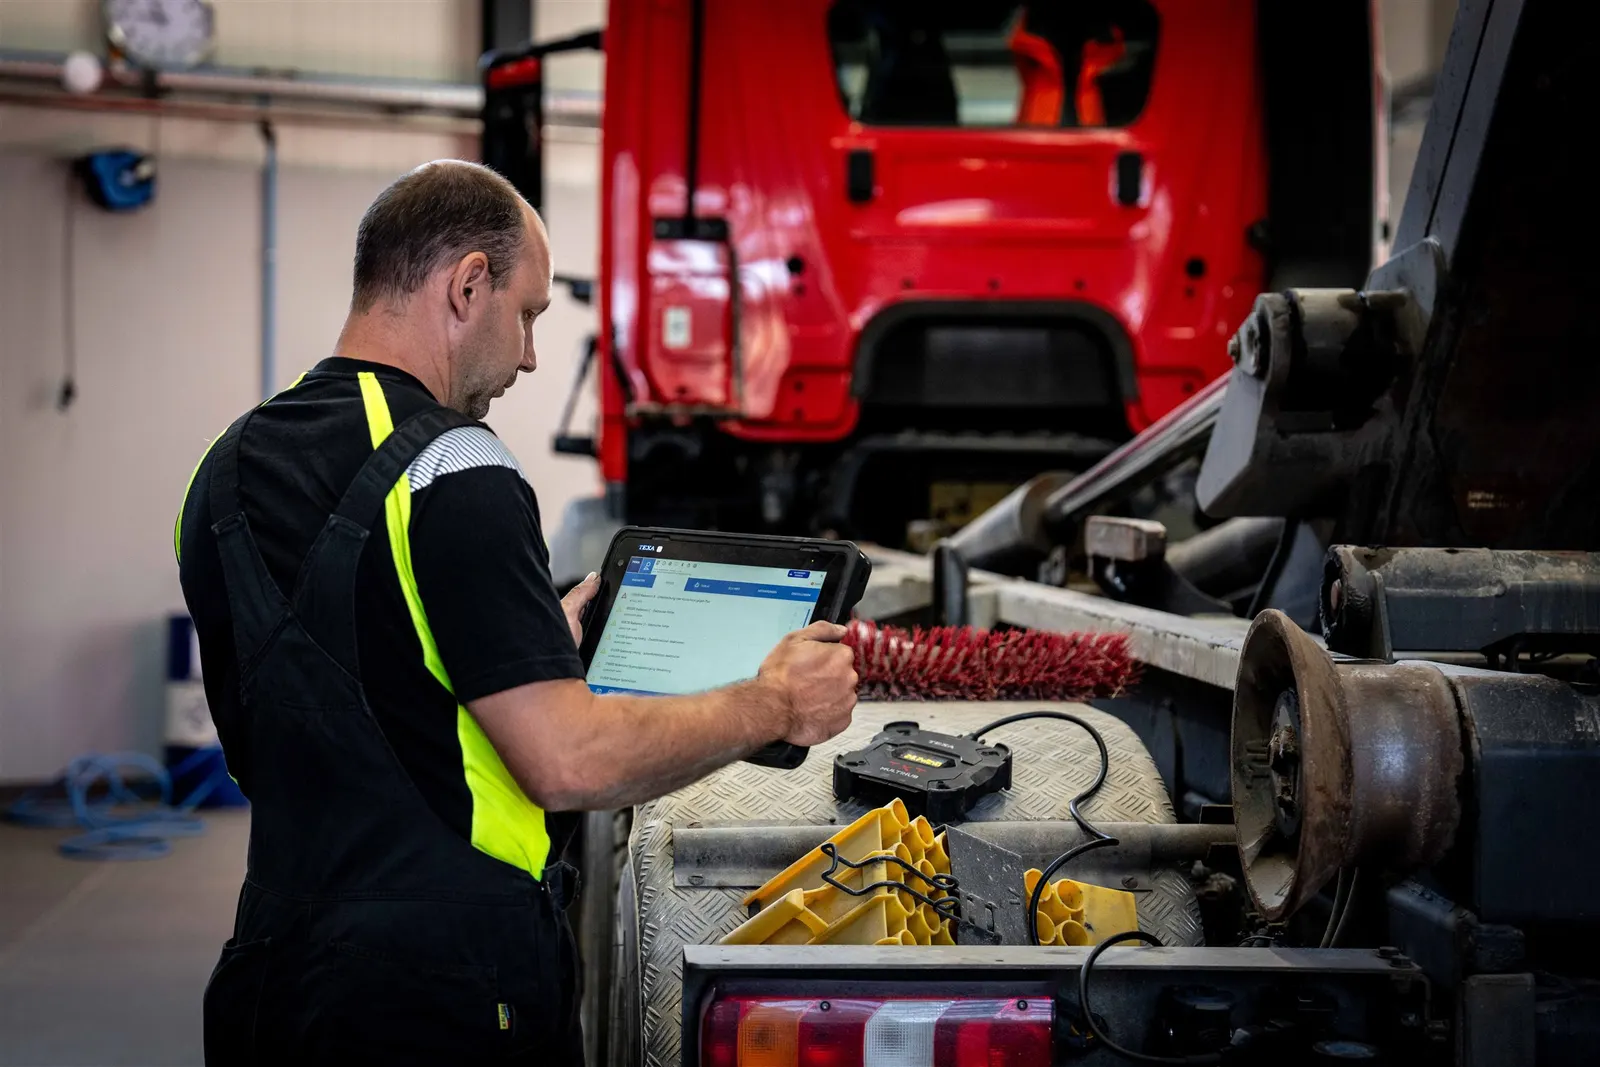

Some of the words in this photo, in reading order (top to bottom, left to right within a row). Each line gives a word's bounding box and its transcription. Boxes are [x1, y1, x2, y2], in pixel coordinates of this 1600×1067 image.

[638, 544, 655, 552] TEXA
[928, 739, 954, 750] TEXA
[879, 766, 919, 779] MULTIHUB
